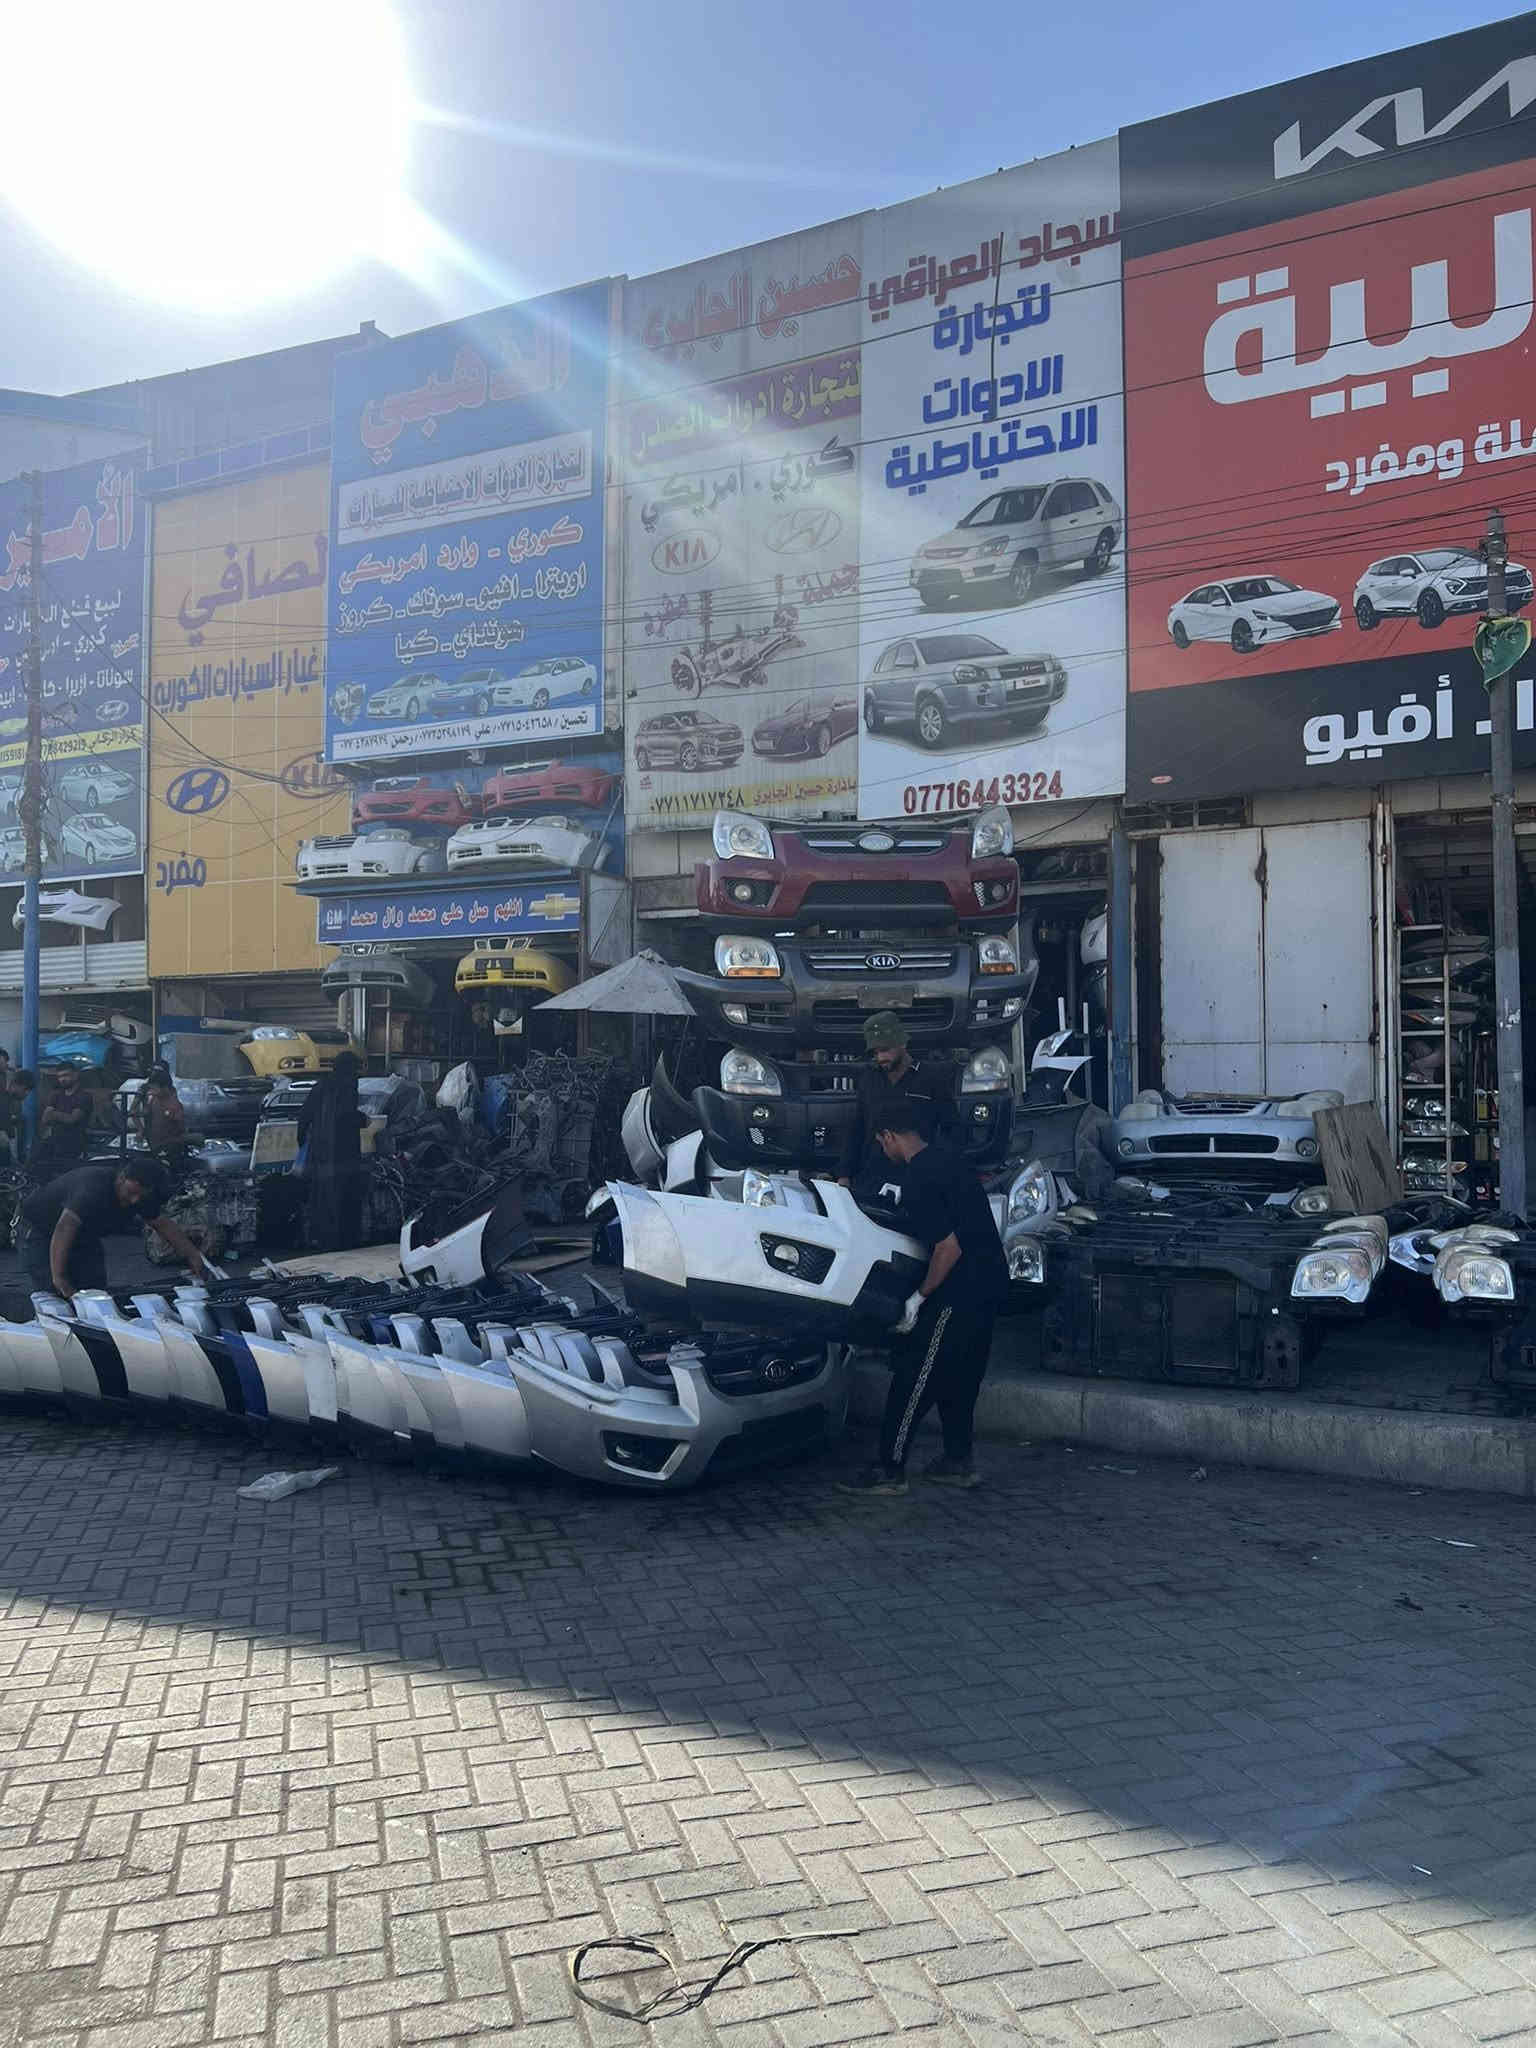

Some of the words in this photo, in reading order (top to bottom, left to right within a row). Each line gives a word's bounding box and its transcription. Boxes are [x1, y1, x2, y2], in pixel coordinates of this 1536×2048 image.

[1018, 210, 1121, 271] سجاد
[757, 254, 862, 340] حسين
[867, 234, 1000, 324] العراقي
[933, 282, 1051, 356] لتجارة
[922, 353, 1065, 425] الادوات
[885, 404, 1098, 497] الاحتياطية
[1325, 442, 1465, 496] ومفرد
[437, 534, 479, 571] وارد
[507, 514, 584, 564] كوري
[664, 535, 708, 568] KIA
[178, 534, 329, 648] لصافي
[338, 542, 428, 595] امريكي
[394, 628, 439, 664] كيا
[213, 650, 283, 702] السيارات
[1302, 673, 1454, 766] أفيو
[903, 769, 1064, 814] 07716443324
[156, 850, 208, 897] مفرد
[468, 899, 489, 924] صل
[494, 897, 523, 924] اللهم
[872, 956, 896, 966] KIA
